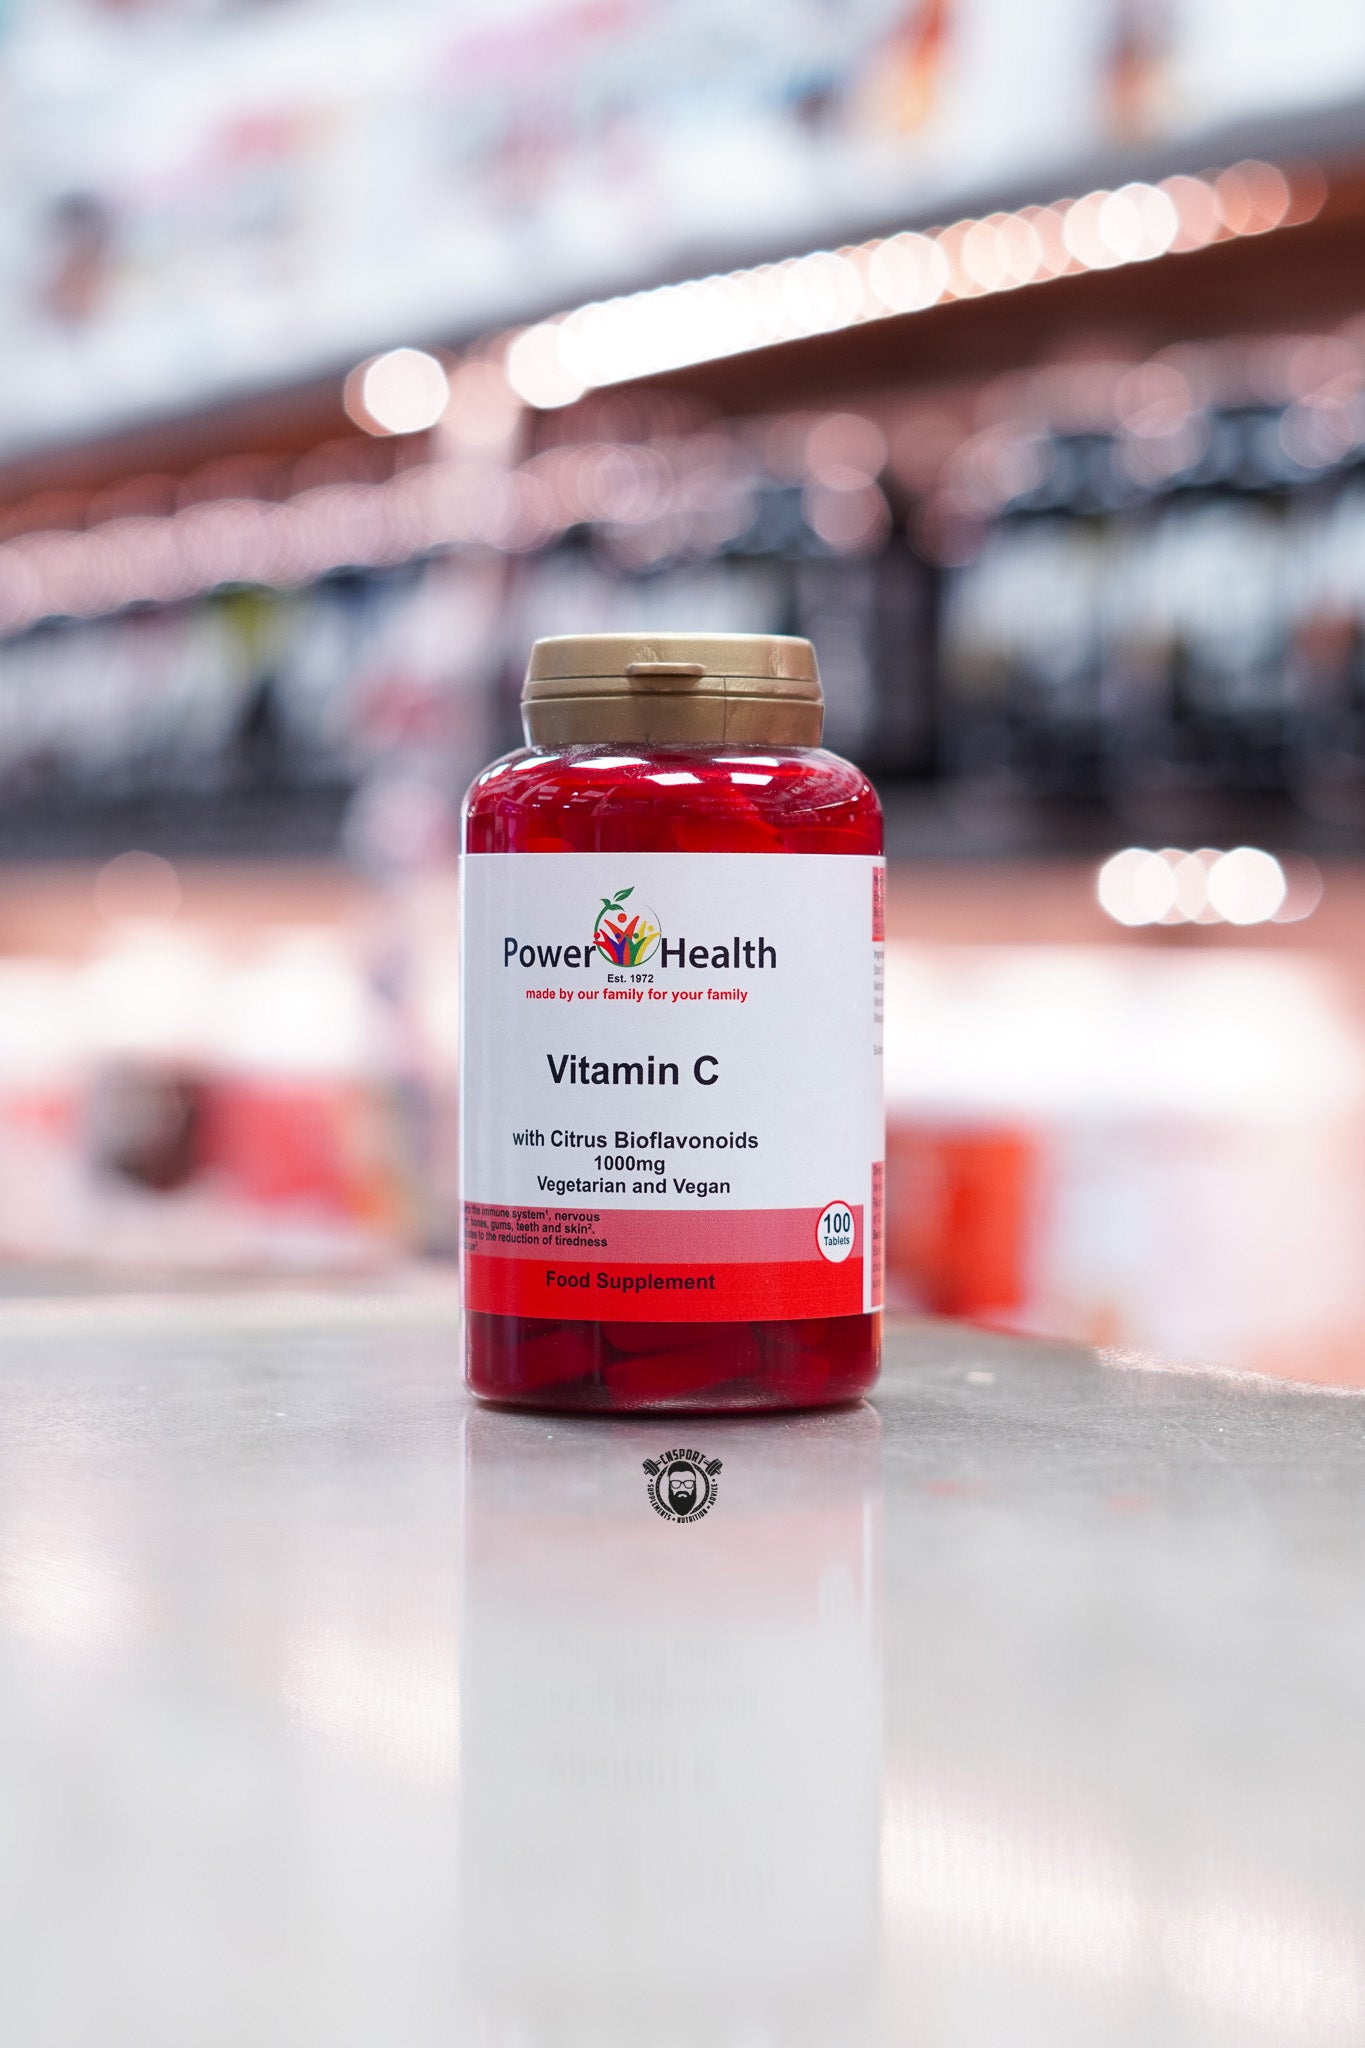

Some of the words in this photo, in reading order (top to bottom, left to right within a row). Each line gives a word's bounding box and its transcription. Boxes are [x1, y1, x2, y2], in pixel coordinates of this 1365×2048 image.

[504, 937, 597, 968] Power
[661, 936, 777, 969] Health
[607, 974, 627, 984] Est.
[630, 974, 654, 984] 1972
[526, 988, 556, 1000] made
[559, 988, 574, 1003] by
[577, 990, 599, 1000] our
[603, 988, 643, 1003] family
[648, 988, 668, 1001] for
[672, 991, 703, 1003] your
[707, 988, 748, 1003] family
[547, 1054, 679, 1085] Vitamin
[694, 1055, 719, 1086] C
[512, 1129, 545, 1147] with
[550, 1129, 608, 1148] Citrus
[615, 1131, 759, 1149] Bioflavonoids
[594, 1155, 665, 1175] 1000mg
[537, 1176, 626, 1195] Vegetarian
[632, 1178, 667, 1194] and
[673, 1178, 730, 1197] Vegan
[482, 1206, 510, 1218] immune
[555, 1212, 600, 1222] nervous
[823, 1212, 851, 1233] 100
[491, 1221, 514, 1232] gums,
[516, 1221, 539, 1232] teeth
[542, 1222, 561, 1233] and
[486, 1231, 496, 1241] the
[498, 1233, 539, 1245] reduction
[542, 1235, 552, 1246] of
[555, 1234, 608, 1247] tiredness
[823, 1236, 850, 1246] Tablets
[546, 1270, 590, 1288] Food
[596, 1272, 716, 1293] Supplement
